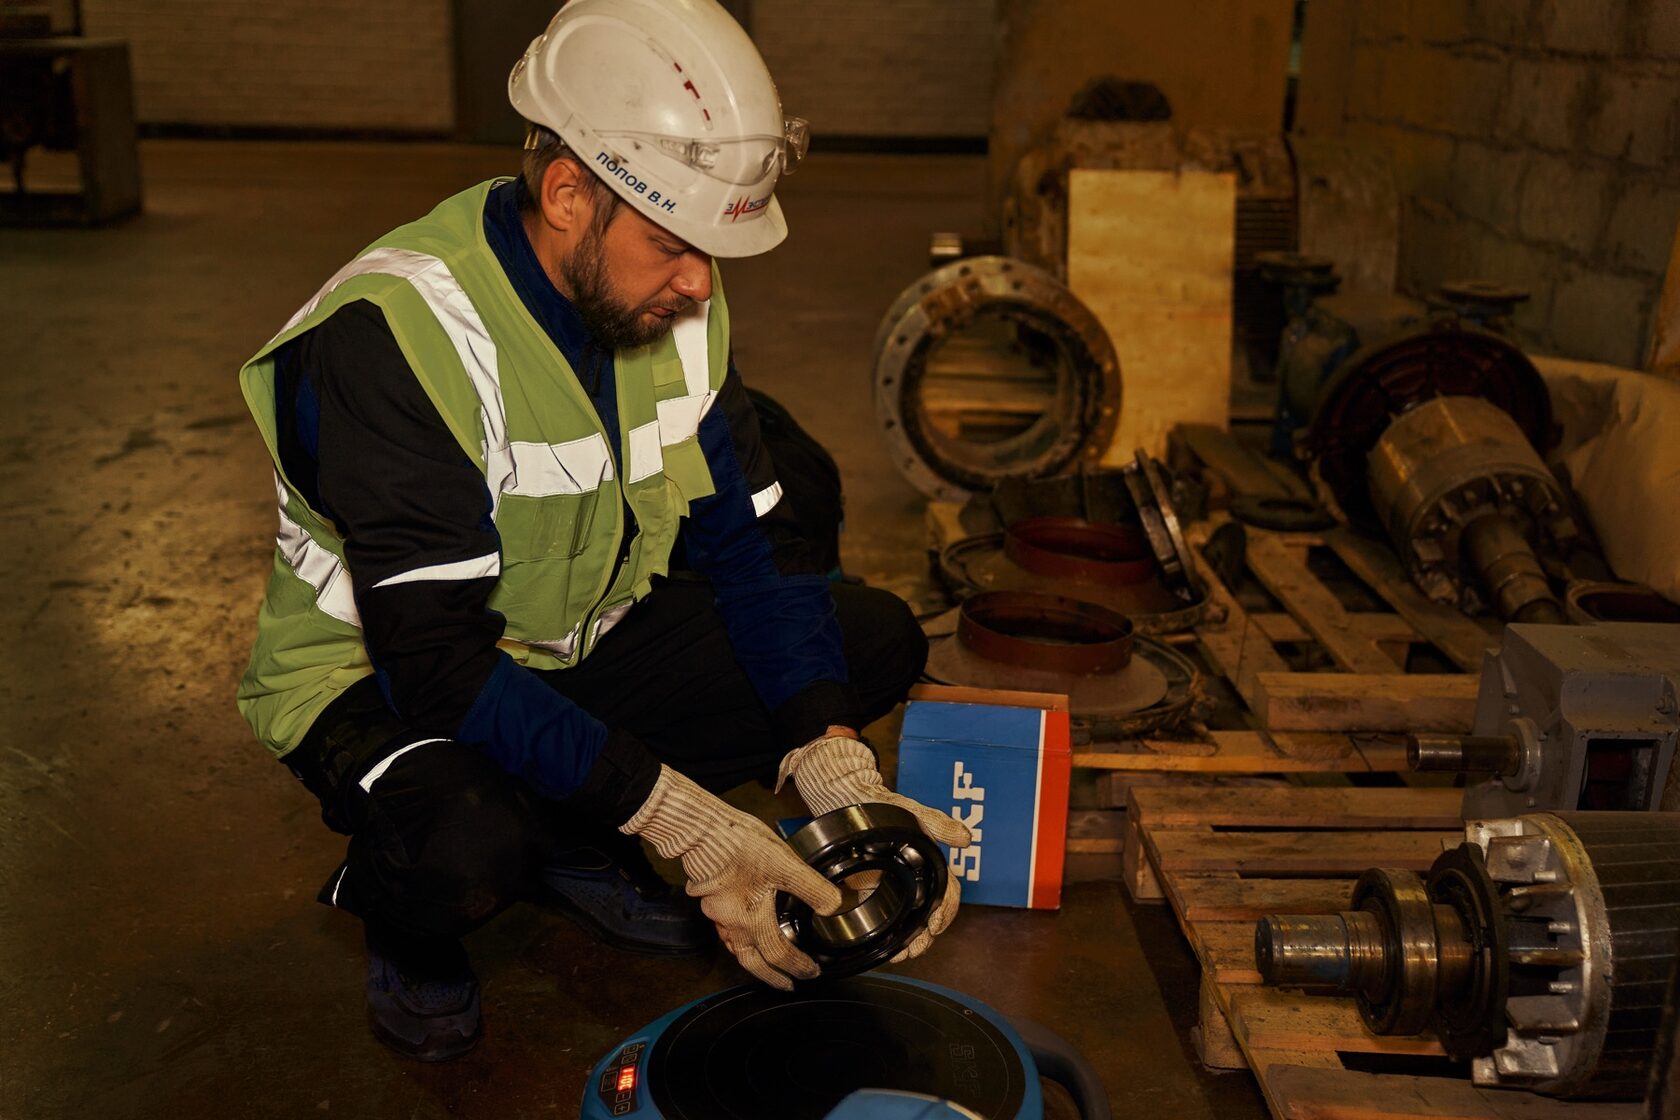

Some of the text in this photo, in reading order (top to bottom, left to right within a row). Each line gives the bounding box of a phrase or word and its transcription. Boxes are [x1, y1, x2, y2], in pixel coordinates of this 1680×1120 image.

[596, 151, 676, 214] ПОПОВ В.Н.
[949, 760, 985, 882] SKF
